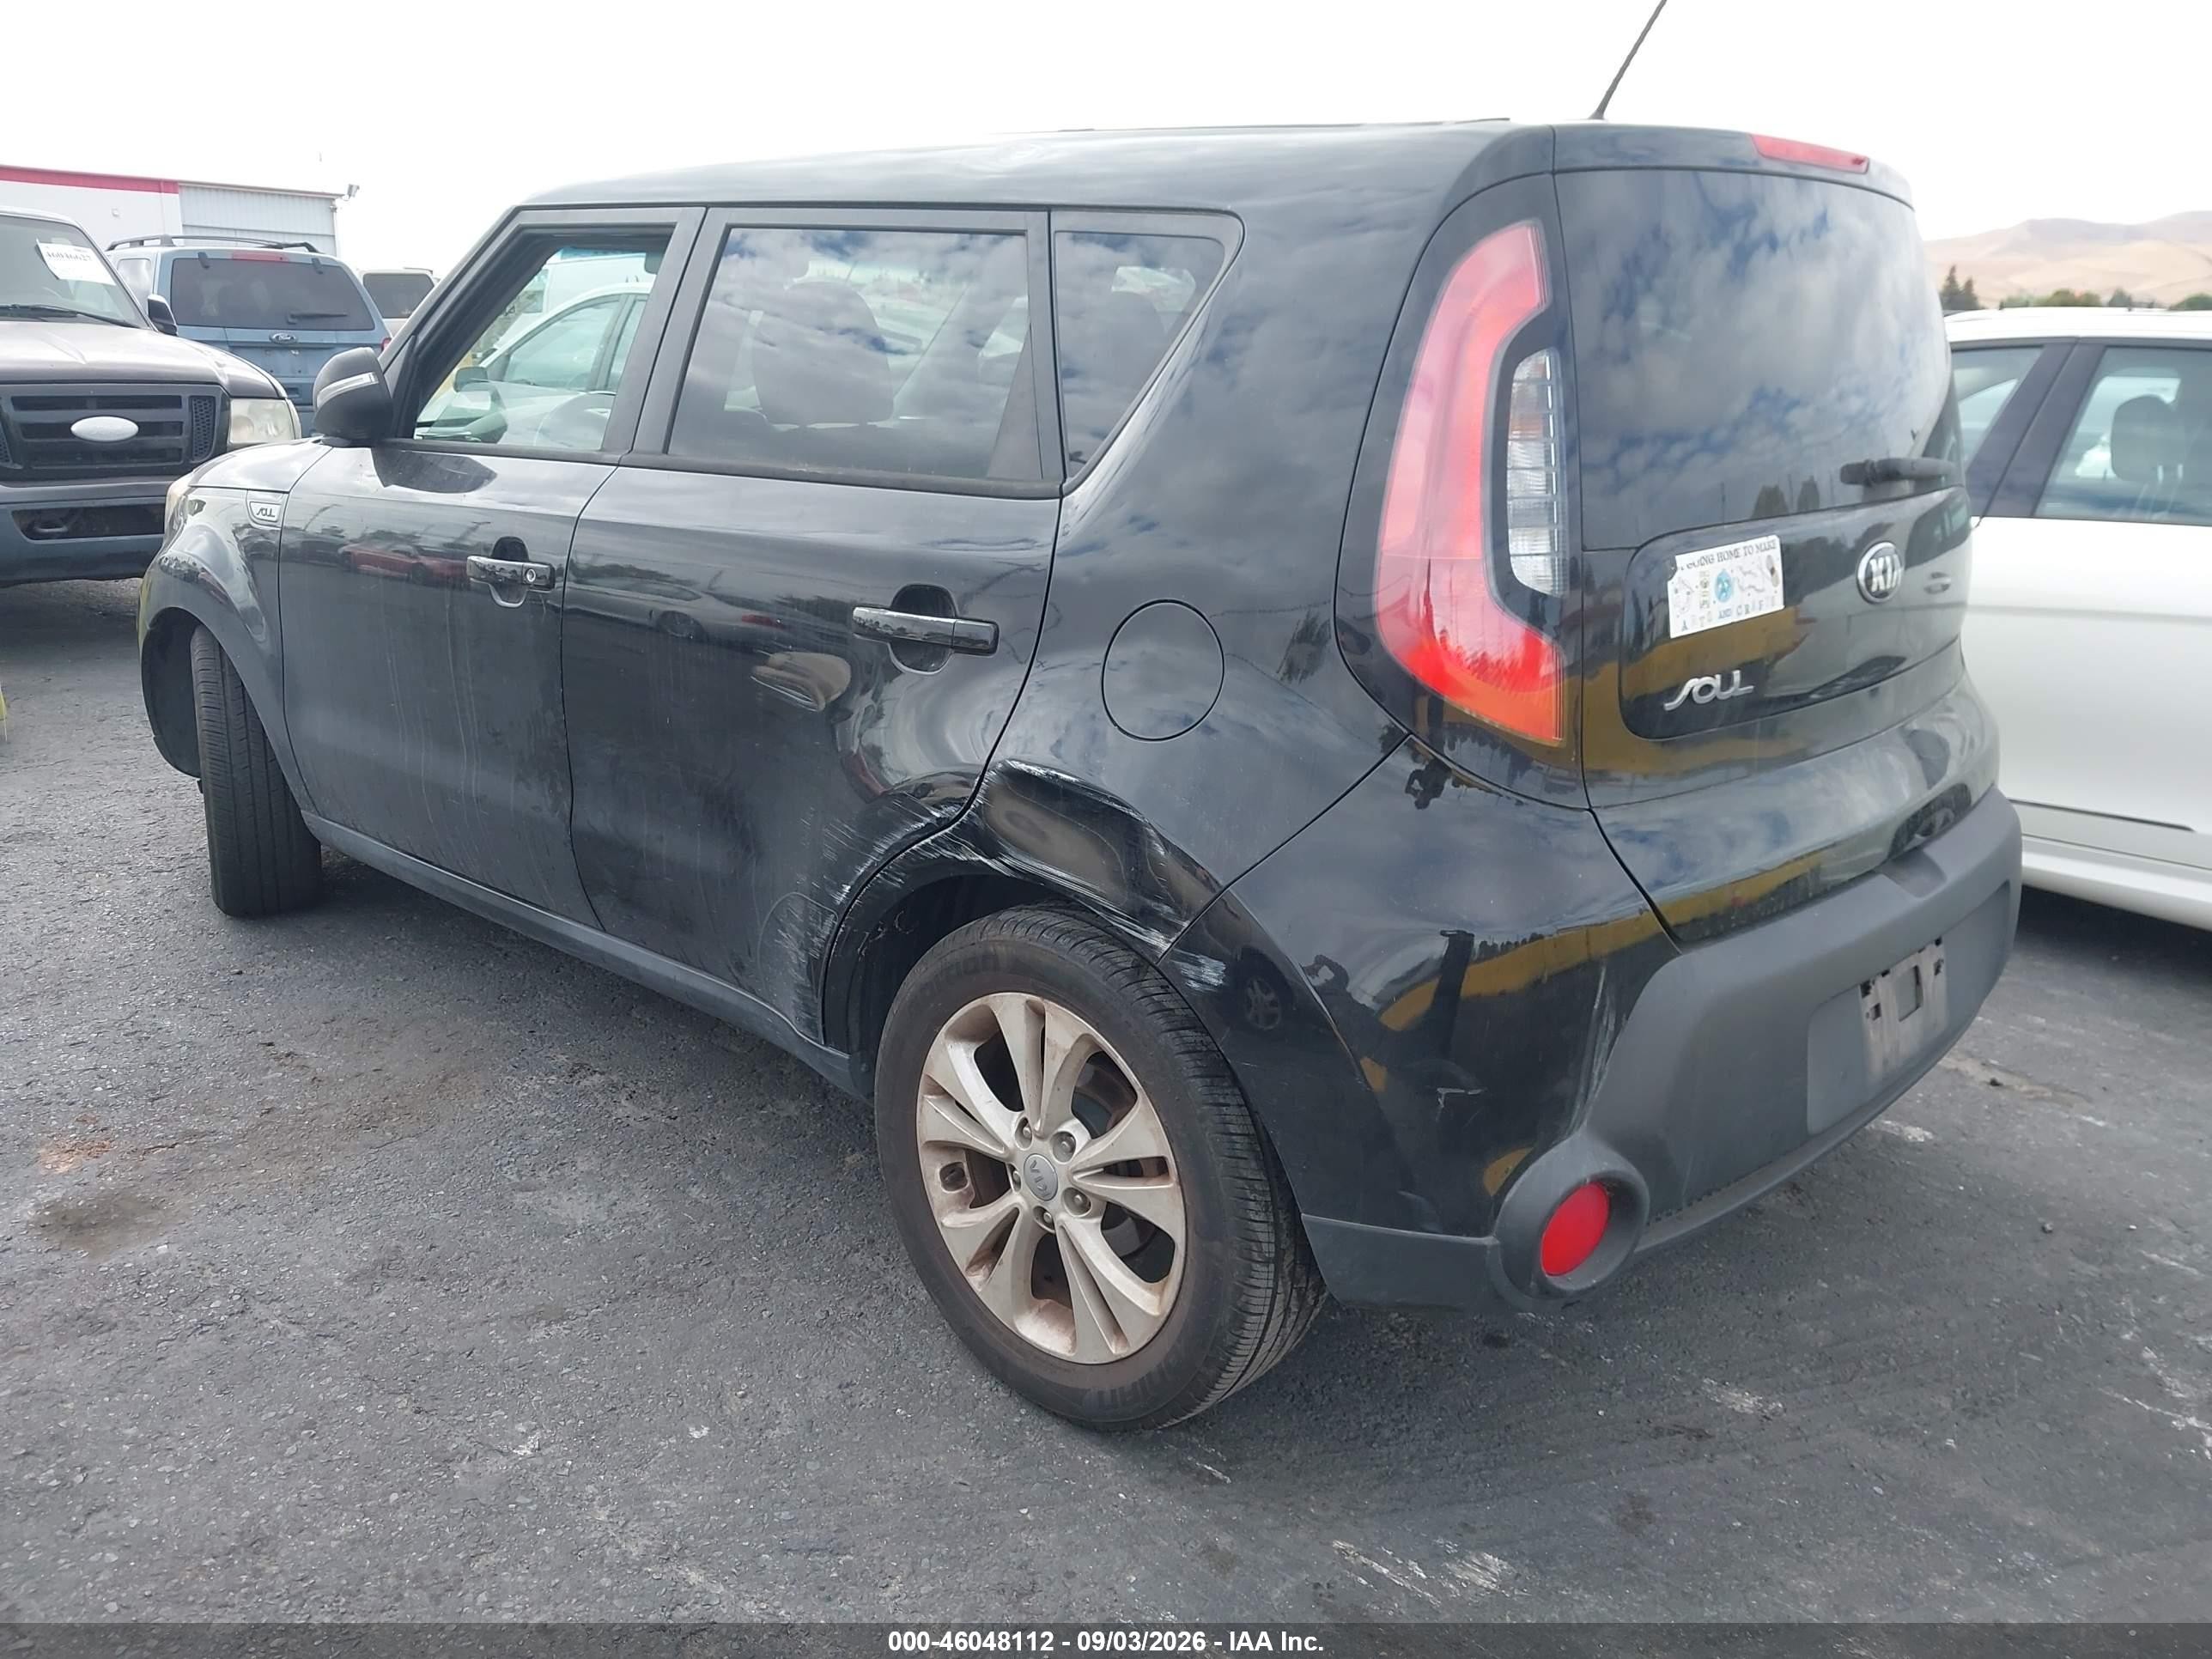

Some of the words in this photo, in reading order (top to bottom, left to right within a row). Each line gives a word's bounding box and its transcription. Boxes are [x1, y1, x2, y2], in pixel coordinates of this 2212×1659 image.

[1717, 548, 1741, 562] HOME
[1743, 544, 1754, 556] TO
[1755, 539, 1777, 553] MAKE
